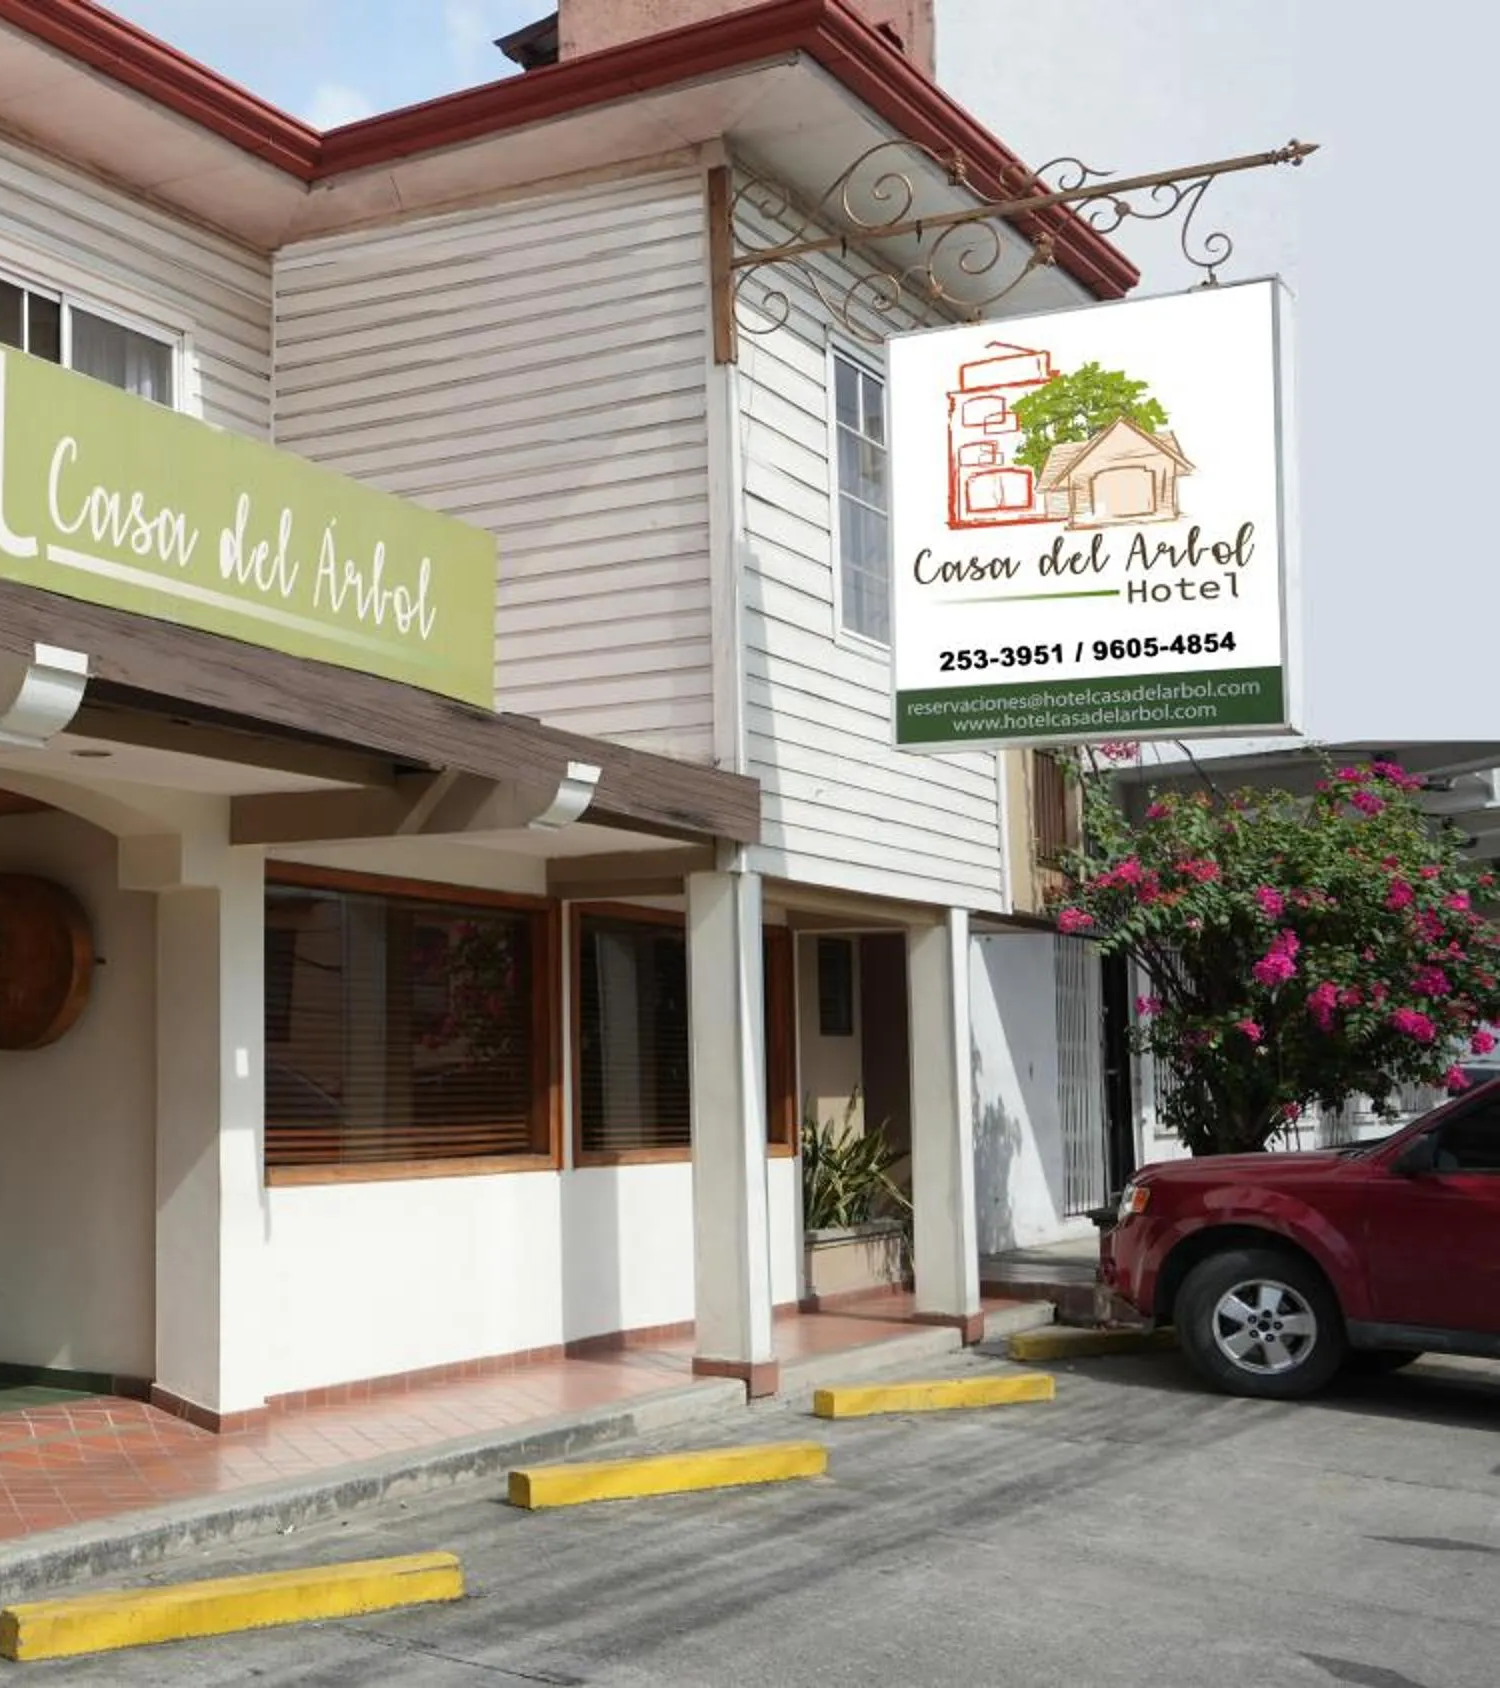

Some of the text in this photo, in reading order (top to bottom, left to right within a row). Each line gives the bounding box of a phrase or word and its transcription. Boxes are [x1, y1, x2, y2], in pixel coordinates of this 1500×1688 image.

[48, 436, 437, 641] Casa del Árbol
[913, 521, 1255, 585] Casa del Arbol
[1127, 571, 1239, 604] Hotel
[939, 631, 1237, 672] 253-3951 / 9605-4854
[907, 678, 1261, 717] reservaciones@hotelcasadelarbol.com
[952, 700, 1217, 733] www.hotelcasadelarbol.com
